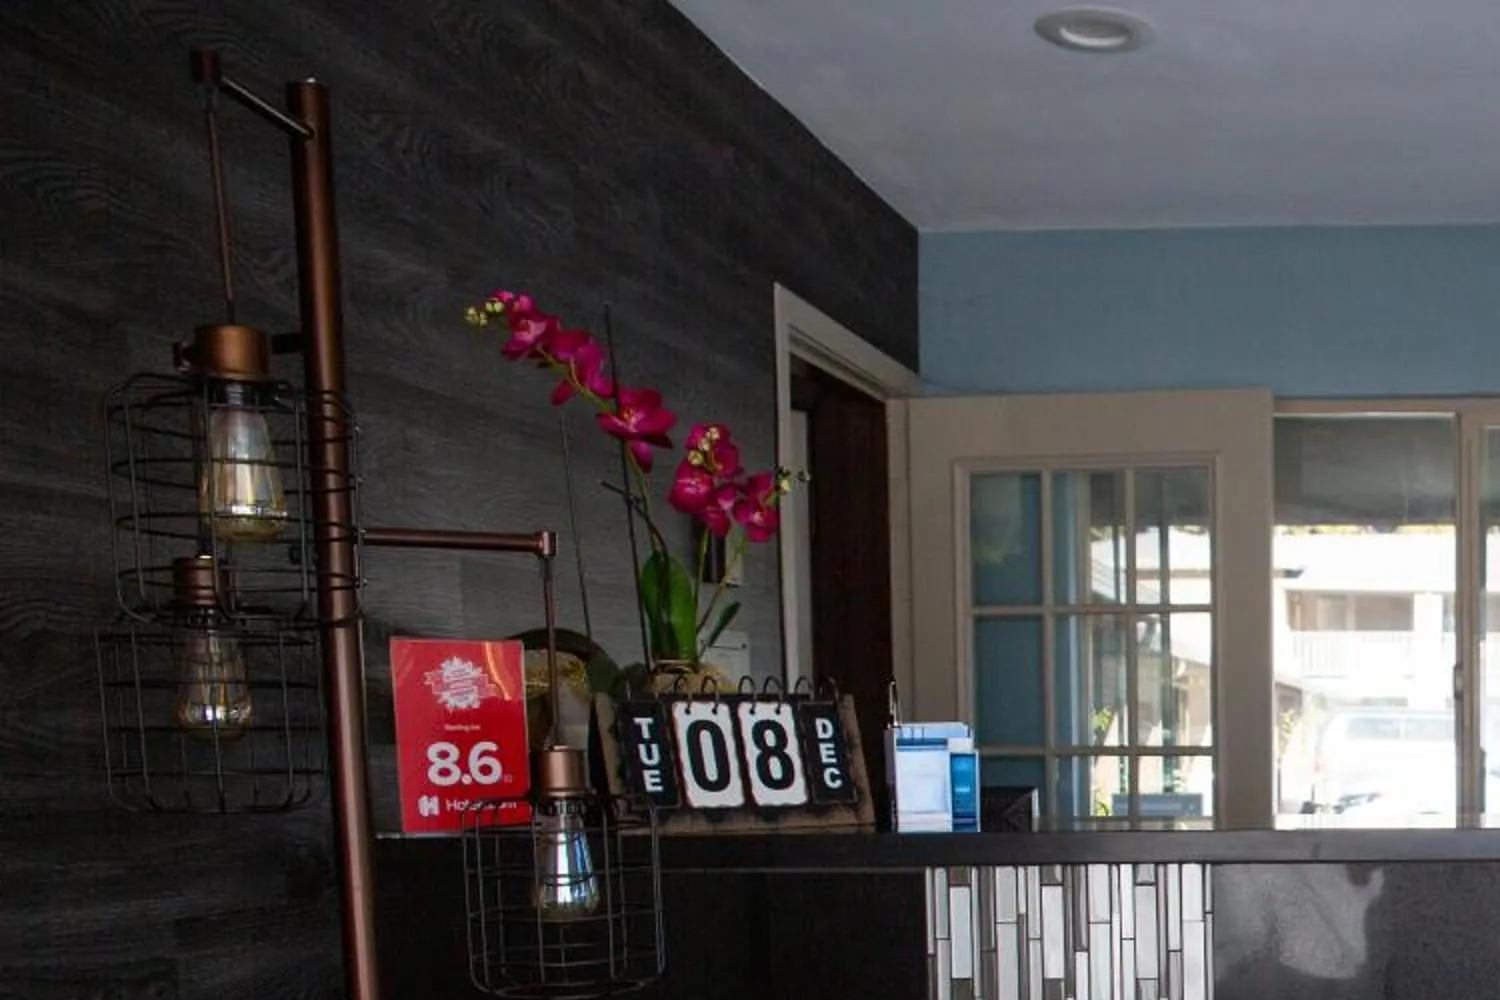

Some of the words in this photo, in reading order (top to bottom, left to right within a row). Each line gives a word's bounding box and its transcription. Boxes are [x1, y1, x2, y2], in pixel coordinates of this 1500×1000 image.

[427, 741, 502, 786] 8.6
[633, 717, 664, 792] TUE
[686, 719, 795, 792] 08
[815, 718, 843, 789] DEC
